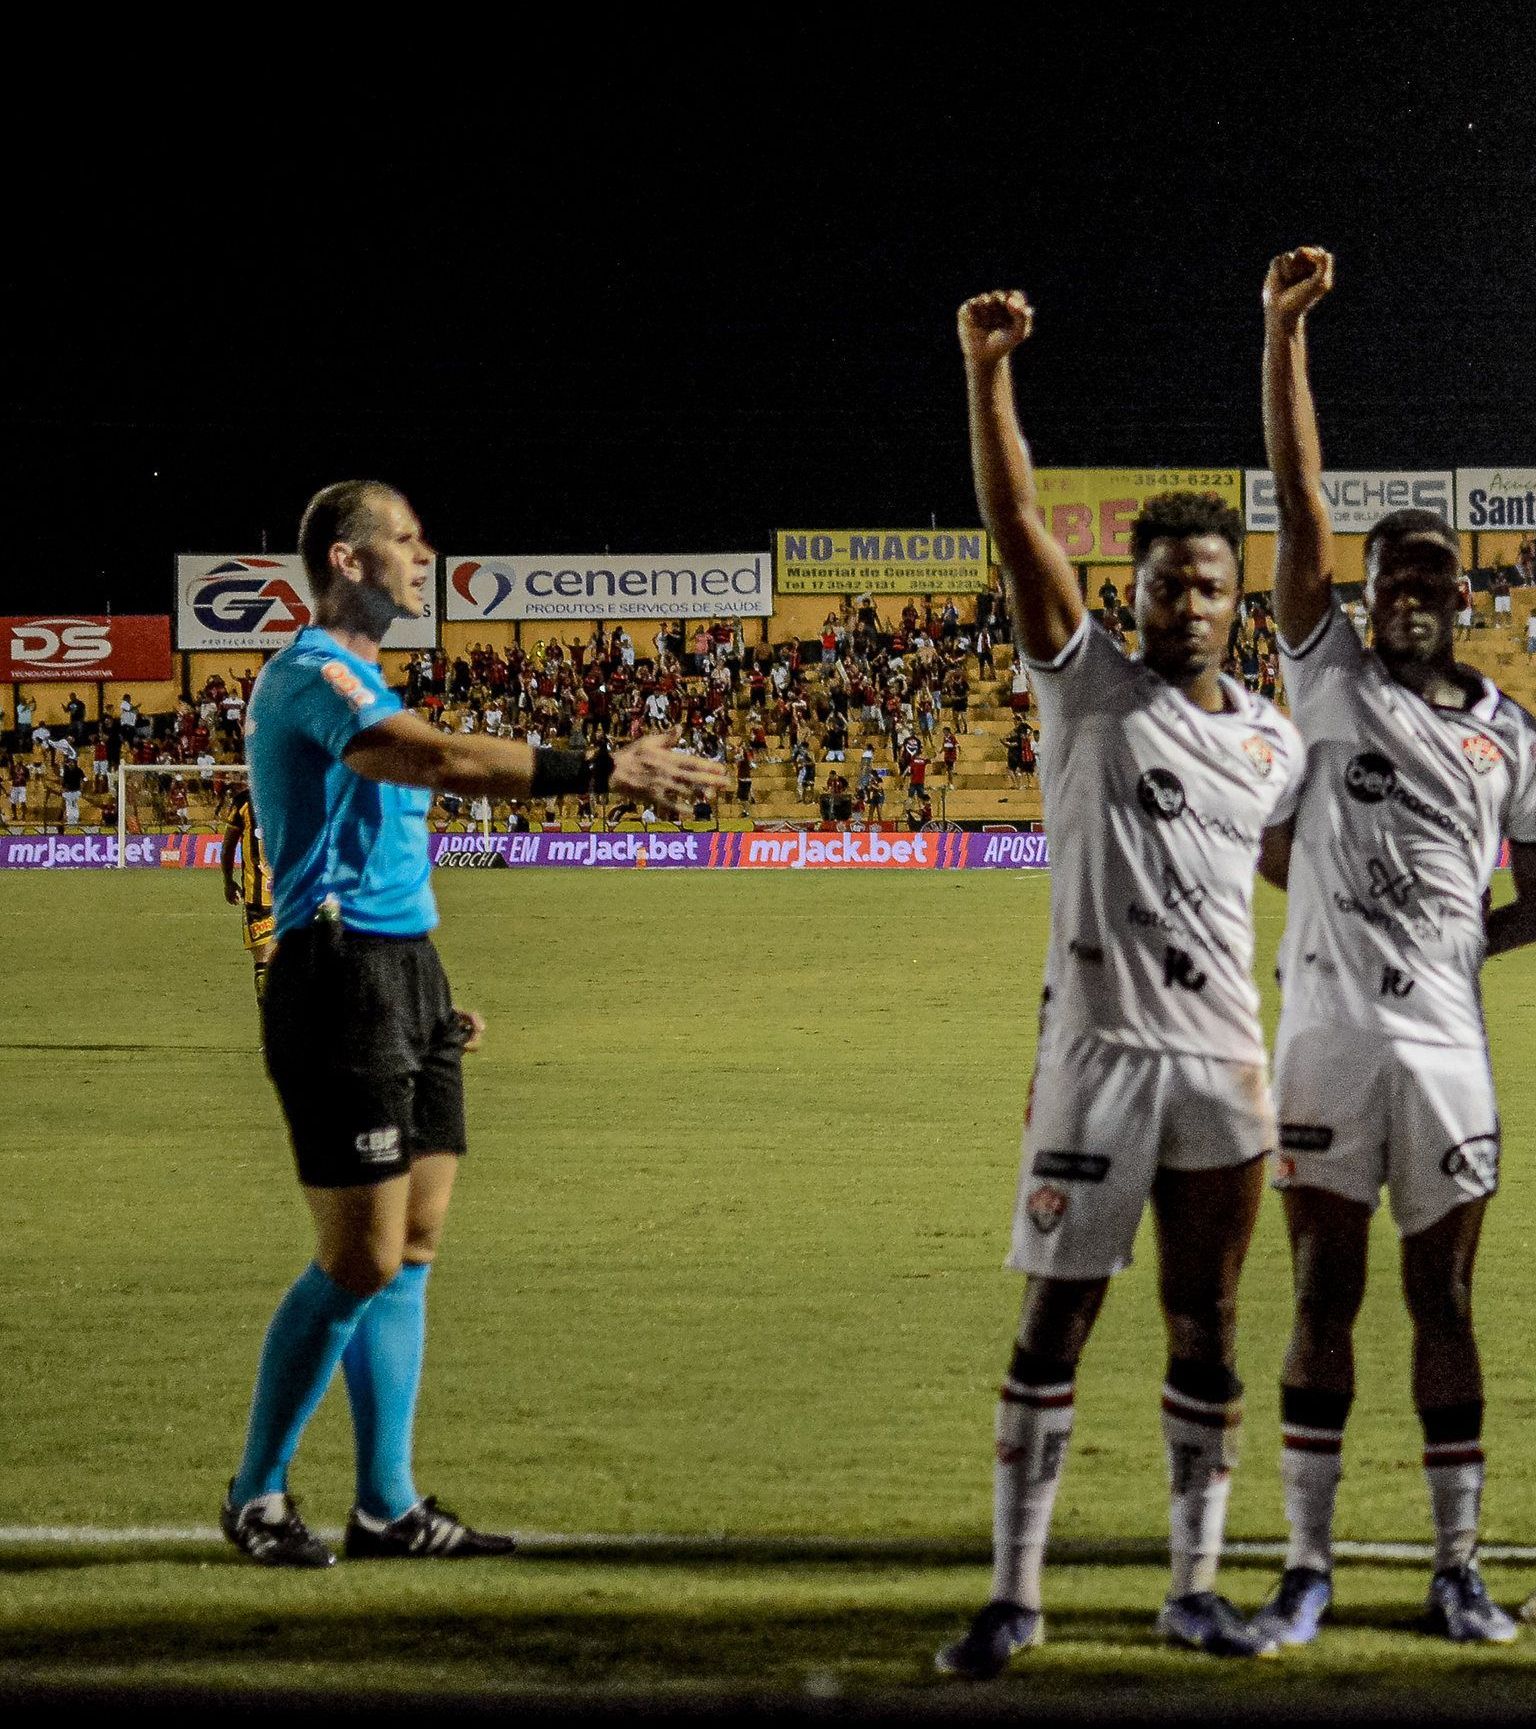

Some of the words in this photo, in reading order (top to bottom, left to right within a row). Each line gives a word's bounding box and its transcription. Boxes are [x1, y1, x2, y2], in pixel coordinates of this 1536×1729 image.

[785, 534, 981, 562] NO-MACON
[525, 557, 761, 597] cenemed
[787, 567, 856, 577] Material
[859, 567, 880, 577] de
[525, 603, 604, 615] PRODUTOS
[608, 602, 617, 614] E
[619, 602, 689, 615] SERVIÇOS
[692, 602, 711, 614] DE
[714, 599, 763, 613] SAÚDE
[11, 626, 112, 661] DS
[509, 836, 540, 862] EM
[983, 836, 1049, 862] APOST
